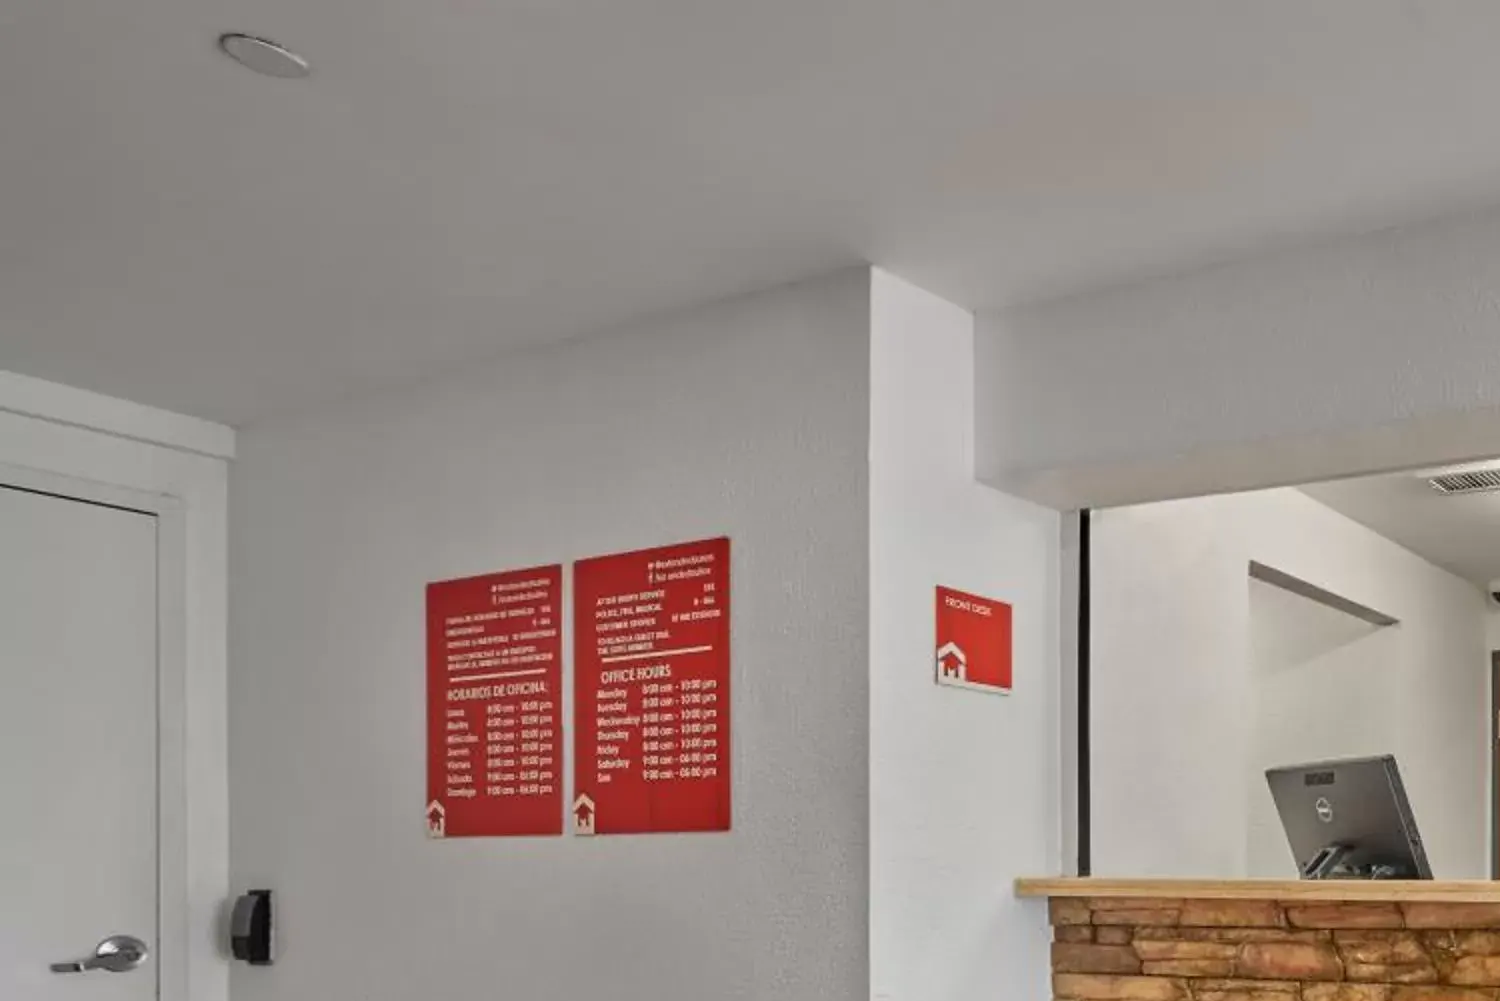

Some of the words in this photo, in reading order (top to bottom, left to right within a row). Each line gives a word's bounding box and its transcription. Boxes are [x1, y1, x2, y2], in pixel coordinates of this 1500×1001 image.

[945, 595, 971, 611] FRONT
[601, 667, 635, 684] OFFICE
[637, 664, 671, 680] HOURS
[493, 684, 506, 697] DE
[597, 688, 627, 699] Monday
[597, 701, 627, 712] Tuesday
[597, 758, 630, 769] Saturday
